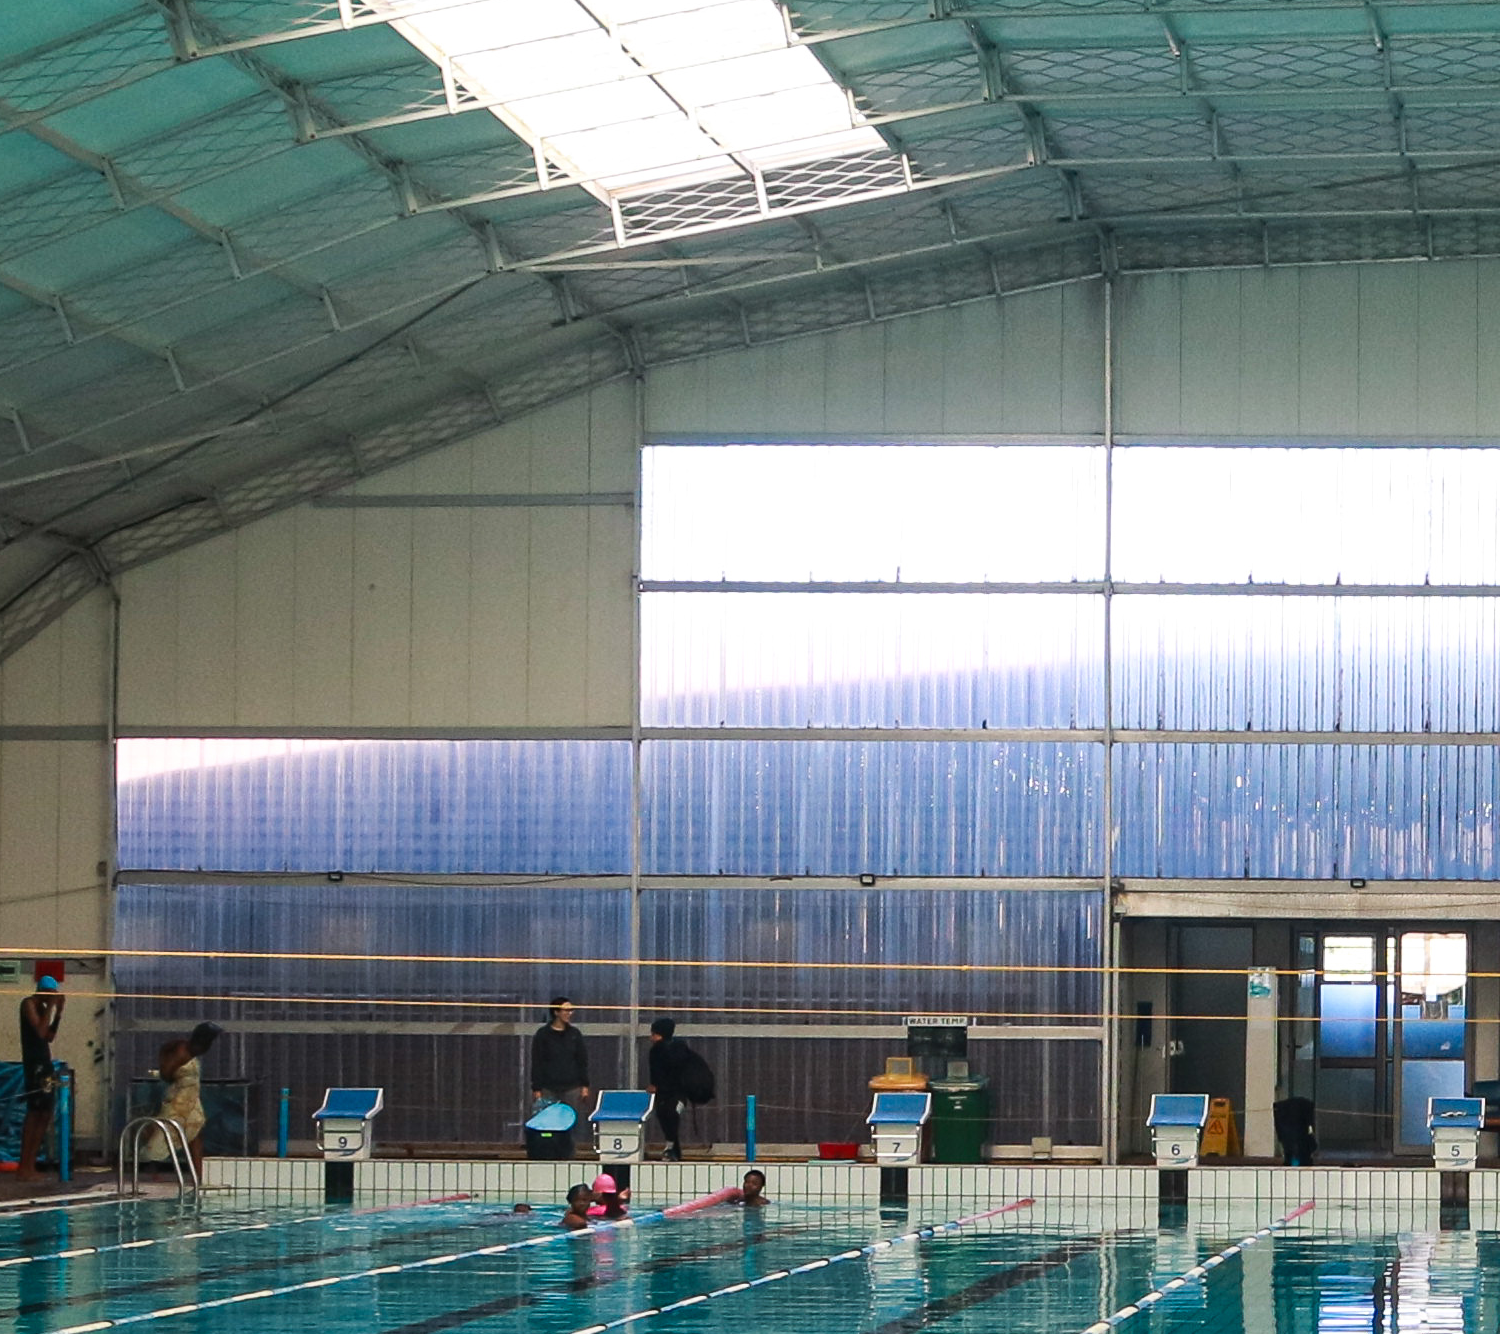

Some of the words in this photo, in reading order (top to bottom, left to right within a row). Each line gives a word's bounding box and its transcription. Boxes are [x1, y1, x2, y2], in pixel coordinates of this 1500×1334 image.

[338, 1137, 348, 1149] 9
[613, 1138, 623, 1150] 8
[892, 1143, 901, 1154] 7
[1171, 1144, 1181, 1156] 6
[1451, 1145, 1460, 1157] 5
